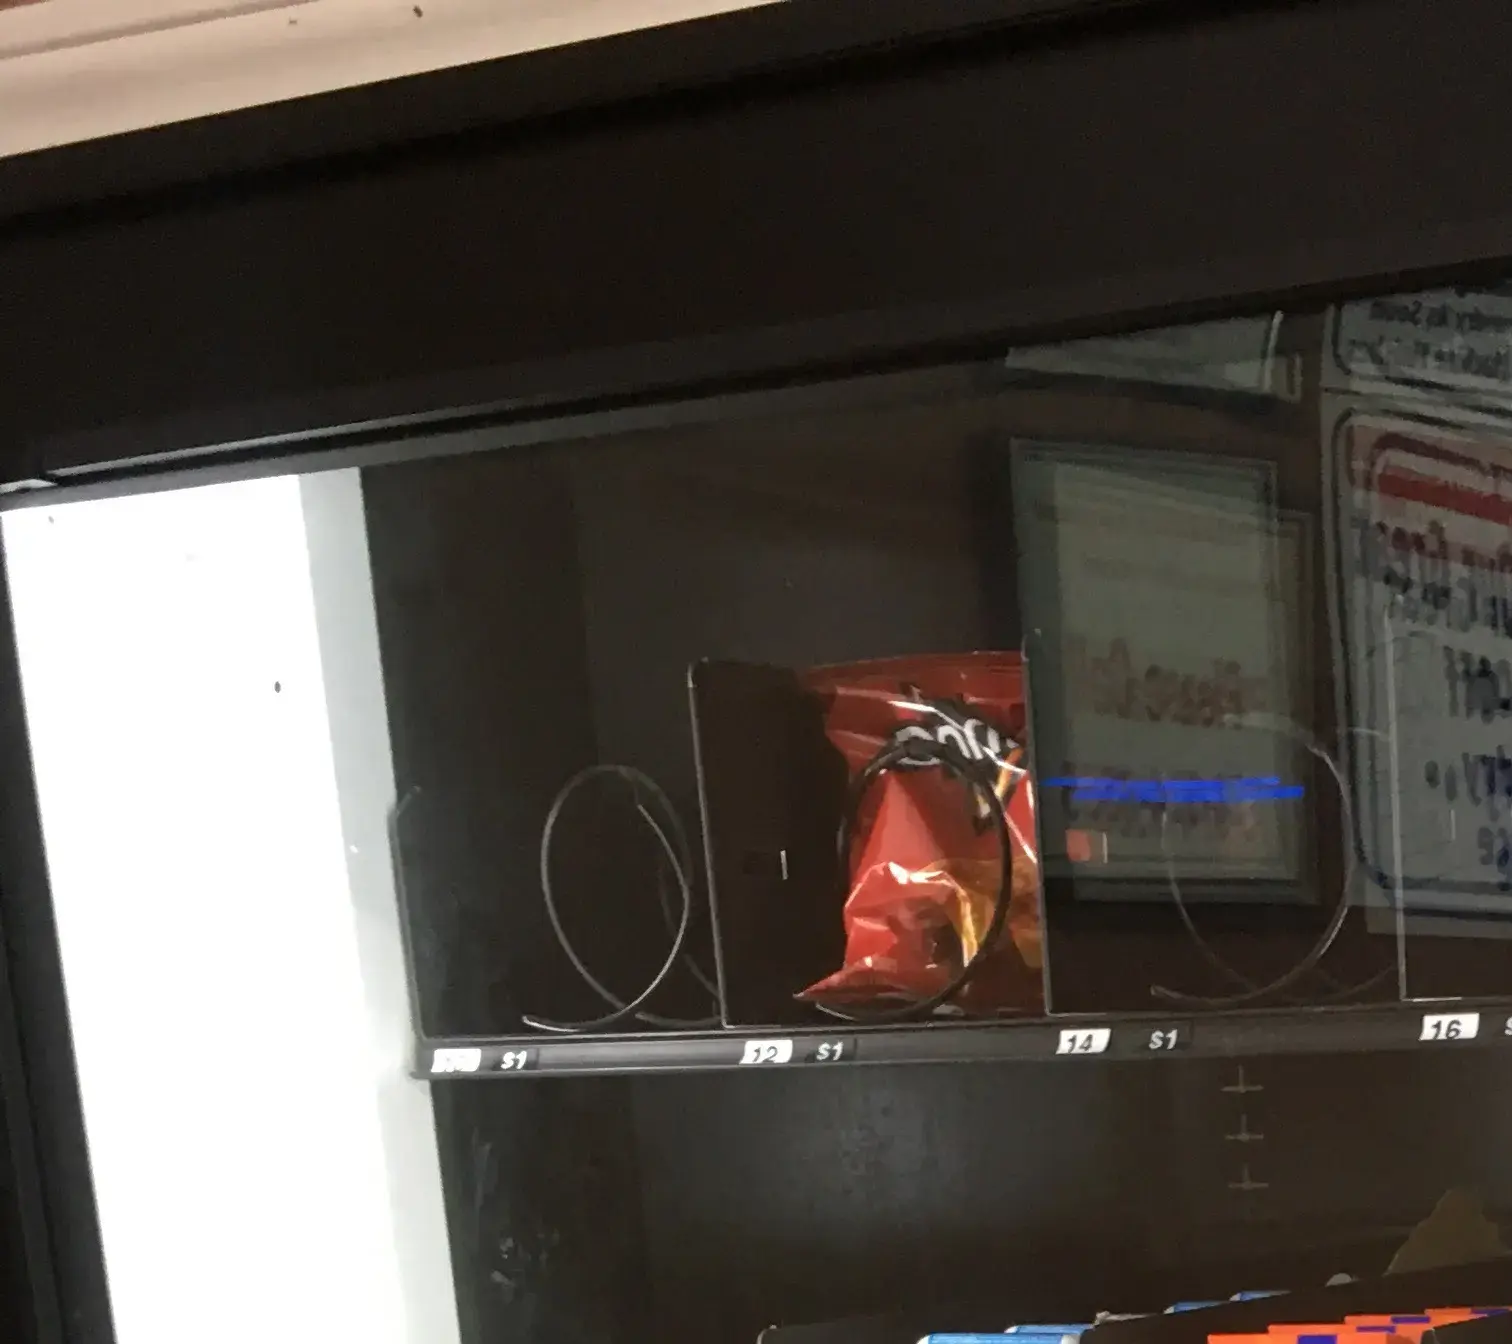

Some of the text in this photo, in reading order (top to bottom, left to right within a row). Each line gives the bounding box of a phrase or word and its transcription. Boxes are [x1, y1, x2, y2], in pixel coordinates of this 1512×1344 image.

[1429, 1019, 1463, 1040] 16
[1066, 1030, 1178, 1050] 14 $1
[501, 1052, 527, 1069] $1
[751, 1042, 843, 1063] 12 $1
